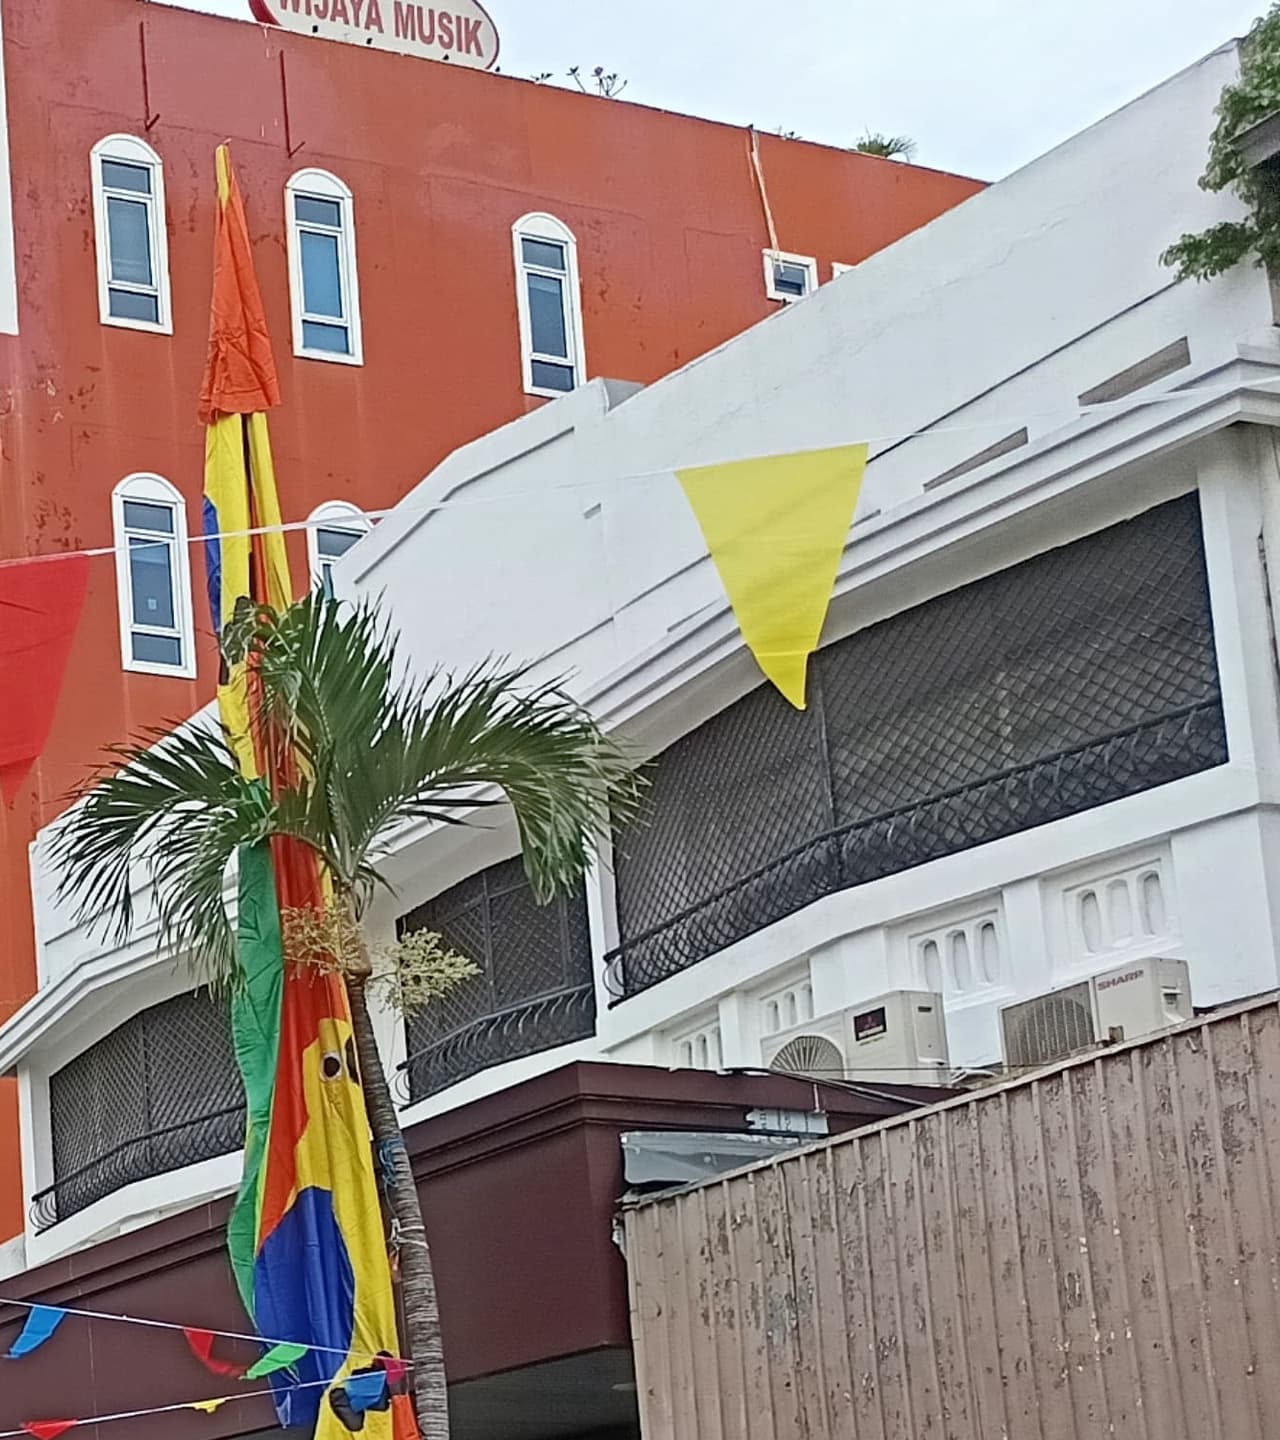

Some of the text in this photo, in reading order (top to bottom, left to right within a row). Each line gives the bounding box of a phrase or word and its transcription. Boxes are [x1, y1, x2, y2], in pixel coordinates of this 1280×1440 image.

[280, 0, 485, 58] JAYA MUSIK
[1097, 969, 1144, 991] SHARP
